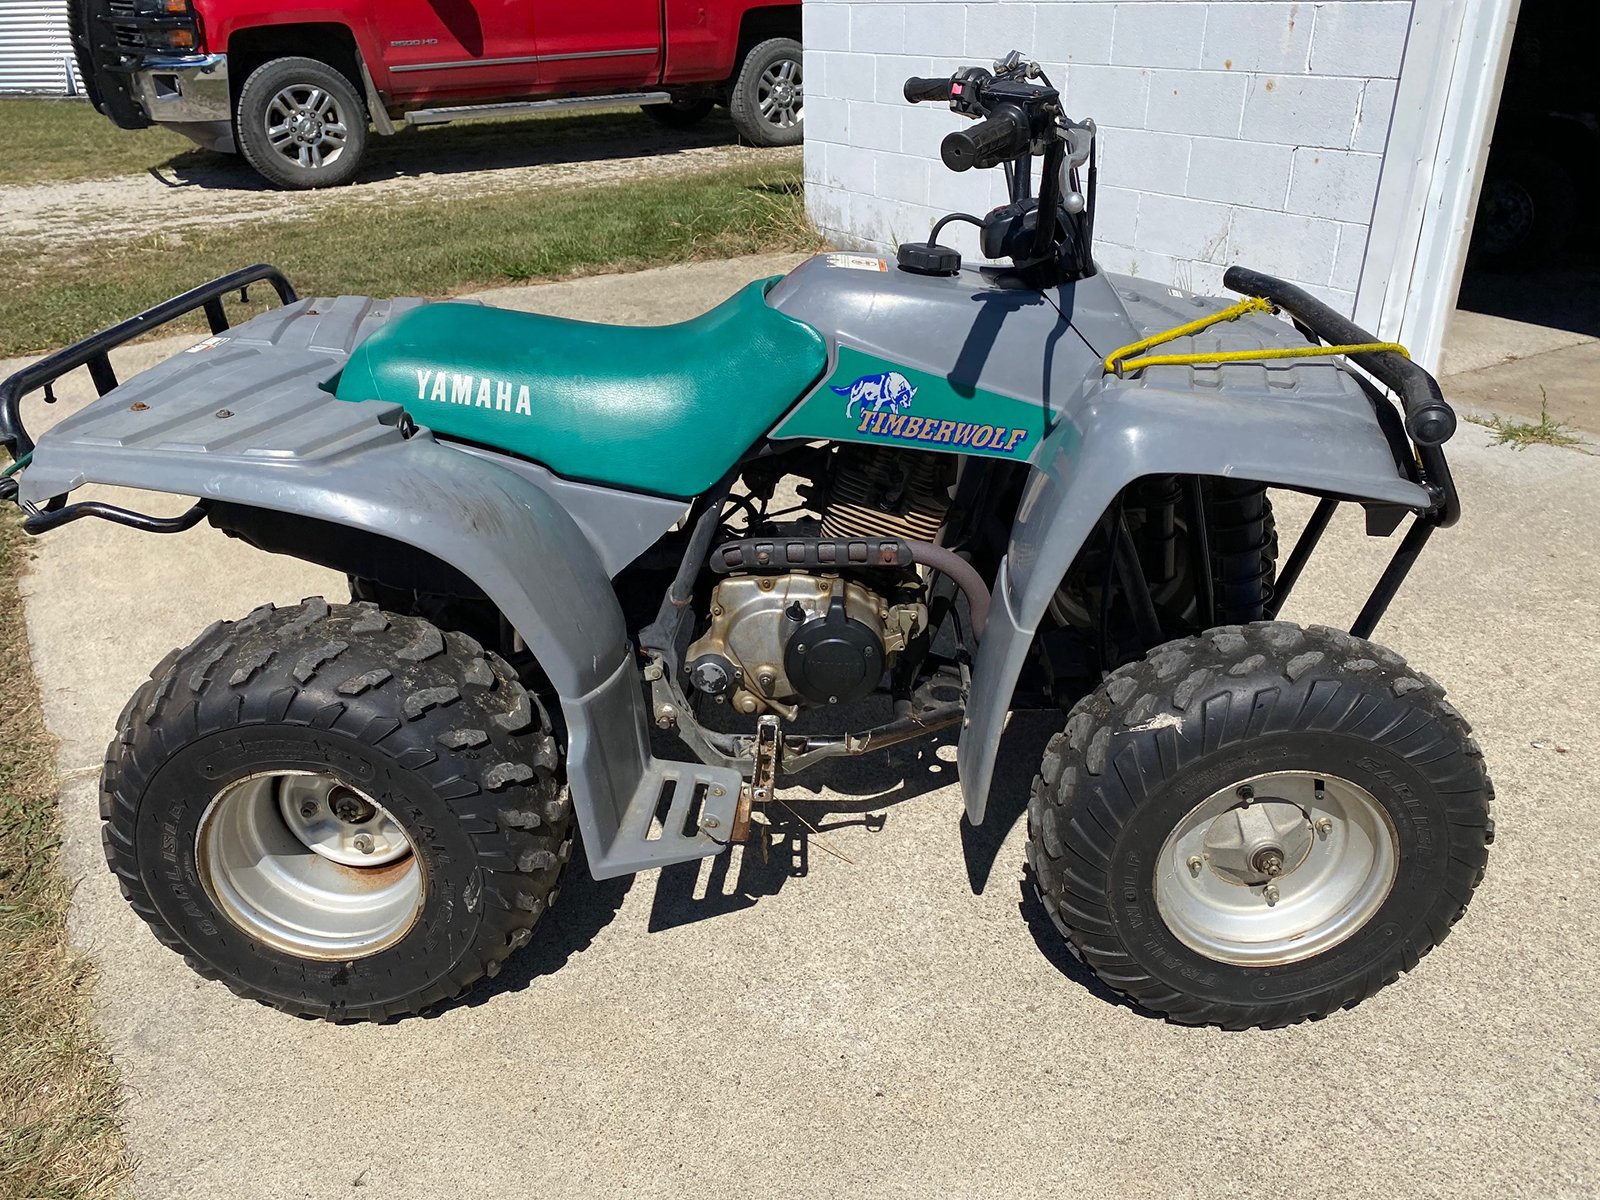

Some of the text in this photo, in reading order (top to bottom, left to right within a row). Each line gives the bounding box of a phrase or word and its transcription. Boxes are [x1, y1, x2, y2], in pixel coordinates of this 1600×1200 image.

[416, 369, 532, 416] YAMAHA
[857, 409, 1028, 453] TIMBERWOLF
[162, 800, 219, 937] CARLISLE
[1143, 932, 1218, 989] TRAIL
